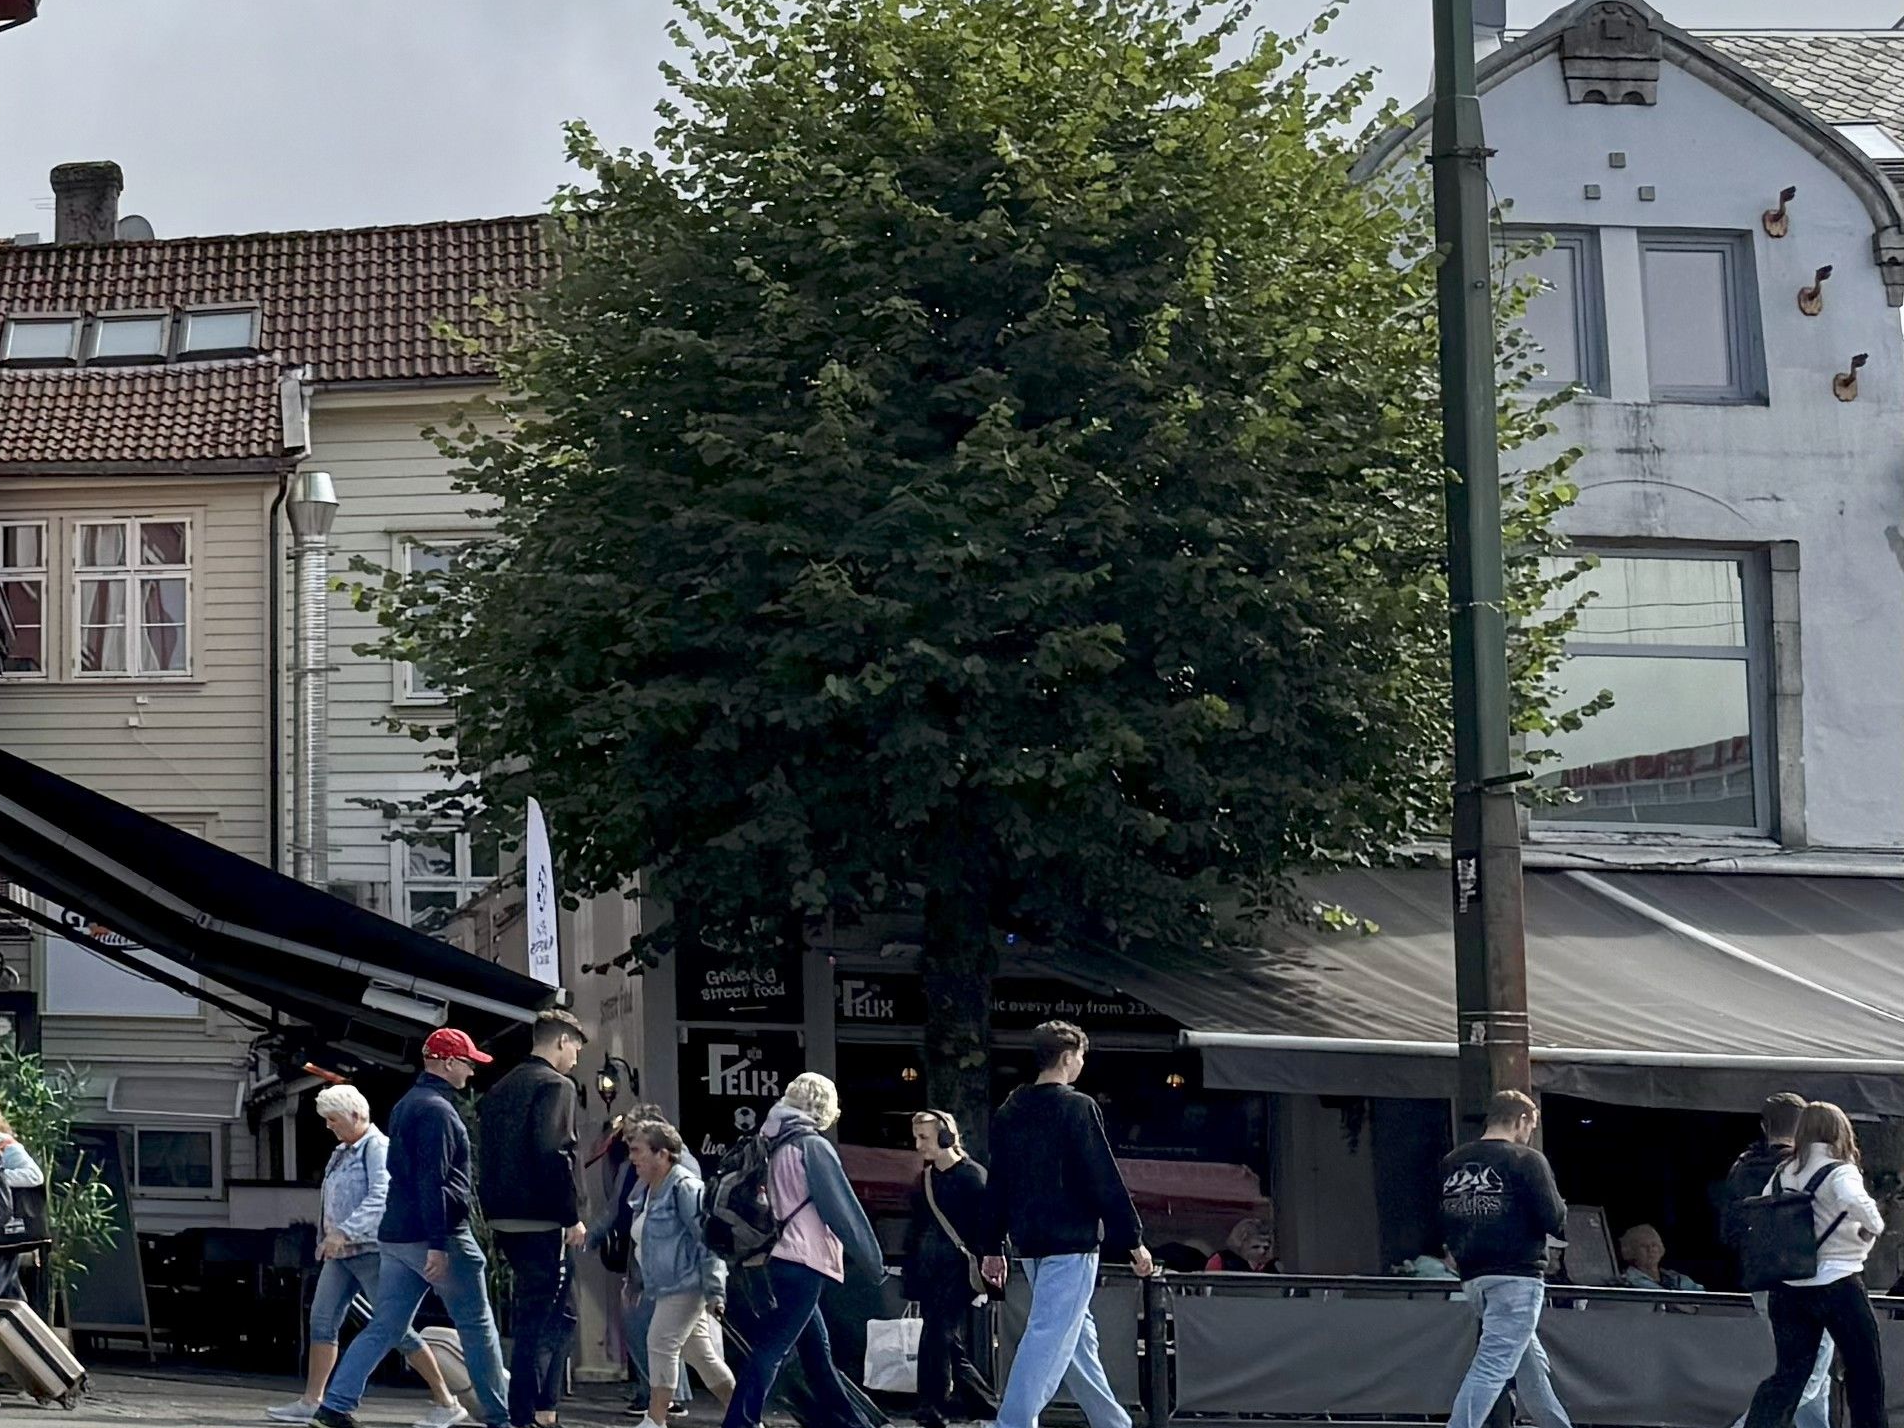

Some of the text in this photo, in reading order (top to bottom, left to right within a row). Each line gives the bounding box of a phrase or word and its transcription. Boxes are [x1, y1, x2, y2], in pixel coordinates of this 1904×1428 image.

[1055, 999, 1083, 1016] day
[1087, 999, 1123, 1014] from
[704, 1043, 780, 1096] FELIX
